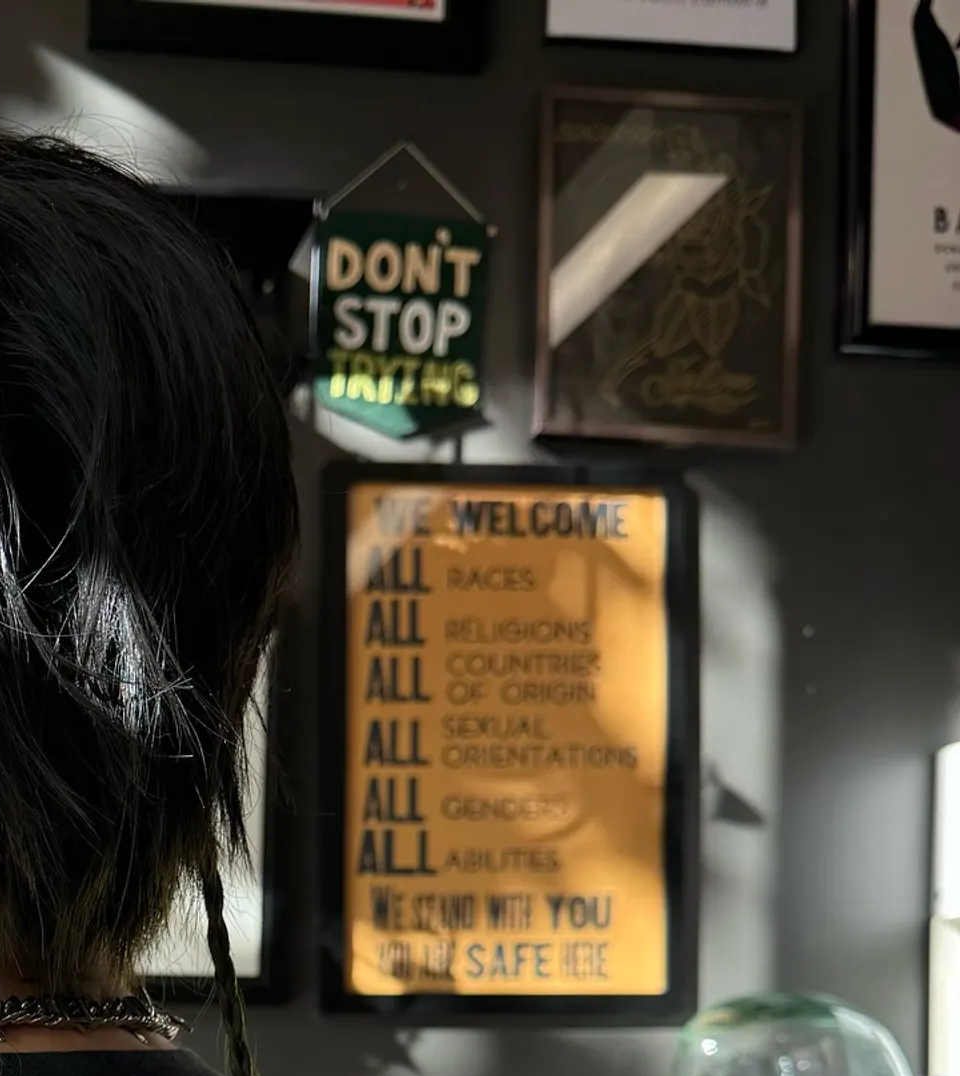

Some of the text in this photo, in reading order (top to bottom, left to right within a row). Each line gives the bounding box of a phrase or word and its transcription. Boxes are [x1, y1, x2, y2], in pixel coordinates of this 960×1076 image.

[326, 227, 482, 297] DON'T
[333, 296, 472, 357] STOP
[327, 350, 480, 407] TRYING
[449, 498, 627, 540] WELCOME
[366, 546, 538, 594] ALL RACES
[366, 599, 425, 646] ALL
[444, 617, 592, 644] RELIGIONS
[366, 650, 601, 703] ALL COUNTRIES
[444, 679, 596, 706] OF ORIGIN
[365, 712, 549, 766] ALL SEXUAL
[442, 742, 638, 769] ORIENTATIONS
[363, 776, 424, 822] ALL
[359, 829, 562, 876] ALL ABILITIES
[371, 886, 405, 930] WE
[486, 894, 532, 931] WITH
[546, 894, 612, 930] YOU
[466, 942, 552, 979] SAFE
